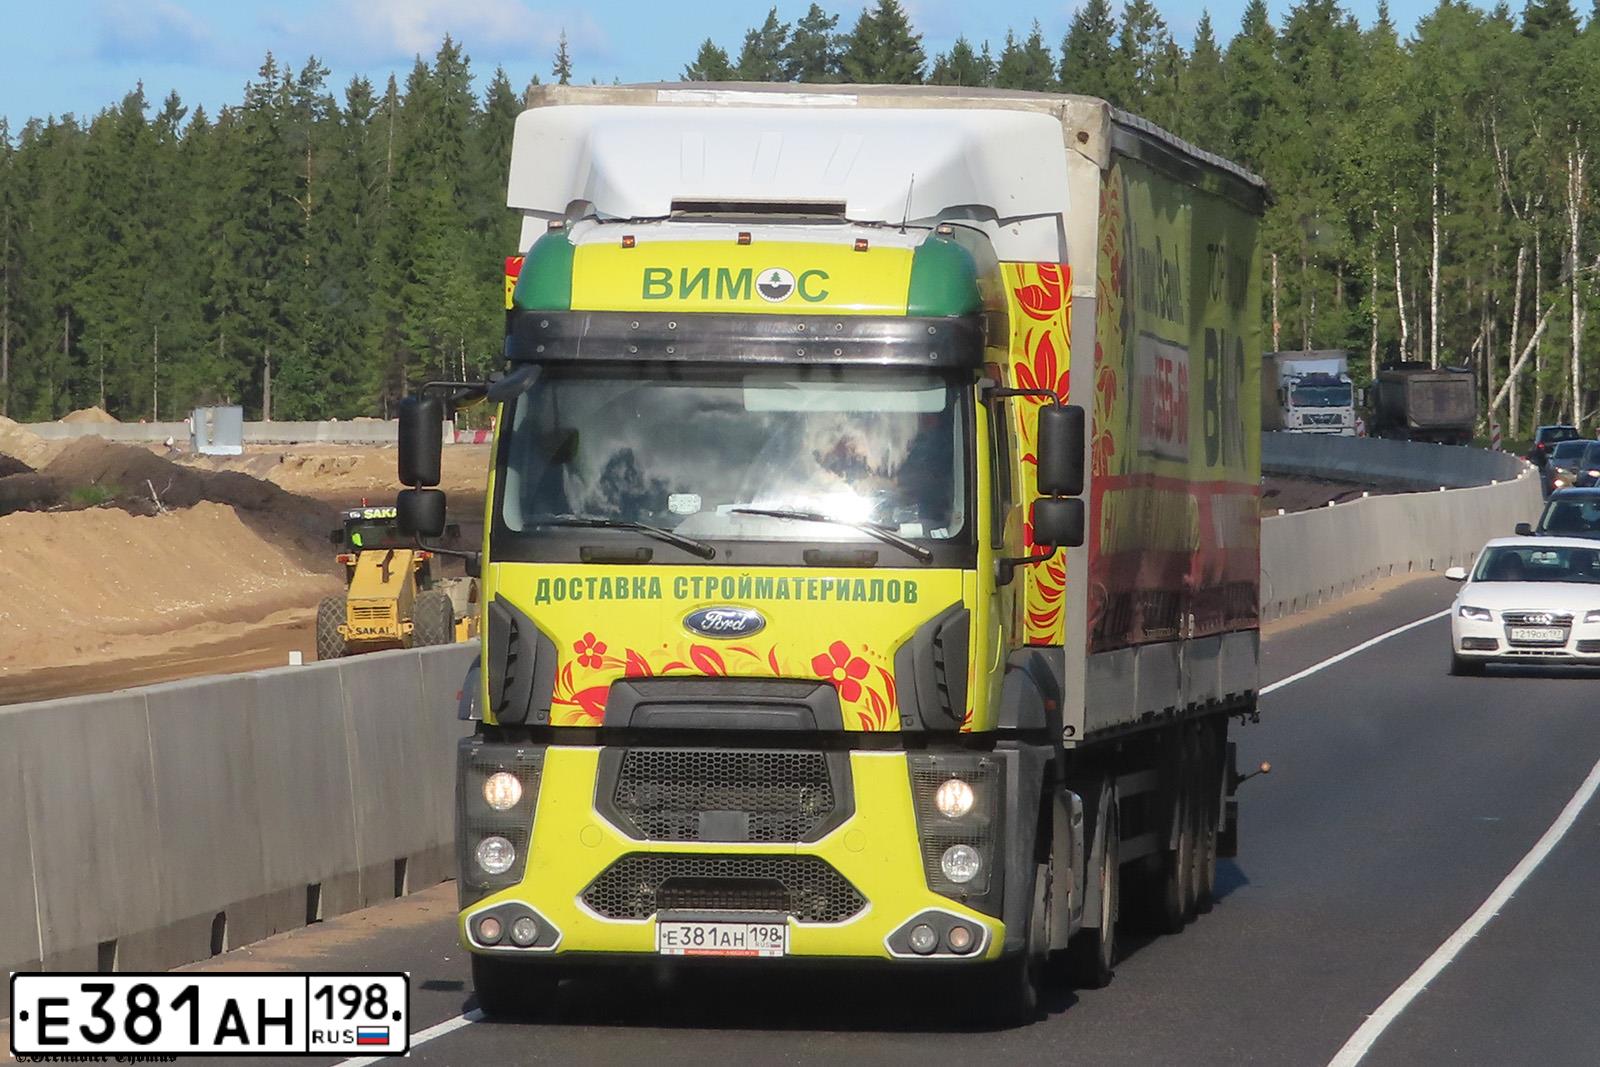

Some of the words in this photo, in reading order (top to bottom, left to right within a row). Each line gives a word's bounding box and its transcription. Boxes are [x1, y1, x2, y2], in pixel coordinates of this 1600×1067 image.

[642, 267, 829, 302] ВИМОС
[535, 576, 662, 604] ДОСТАВКА
[674, 574, 918, 603] СТРОЙМАТЕРИАЛОВ
[701, 611, 746, 630] Ford
[355, 627, 390, 635] SAKAI
[750, 927, 778, 942] 198
